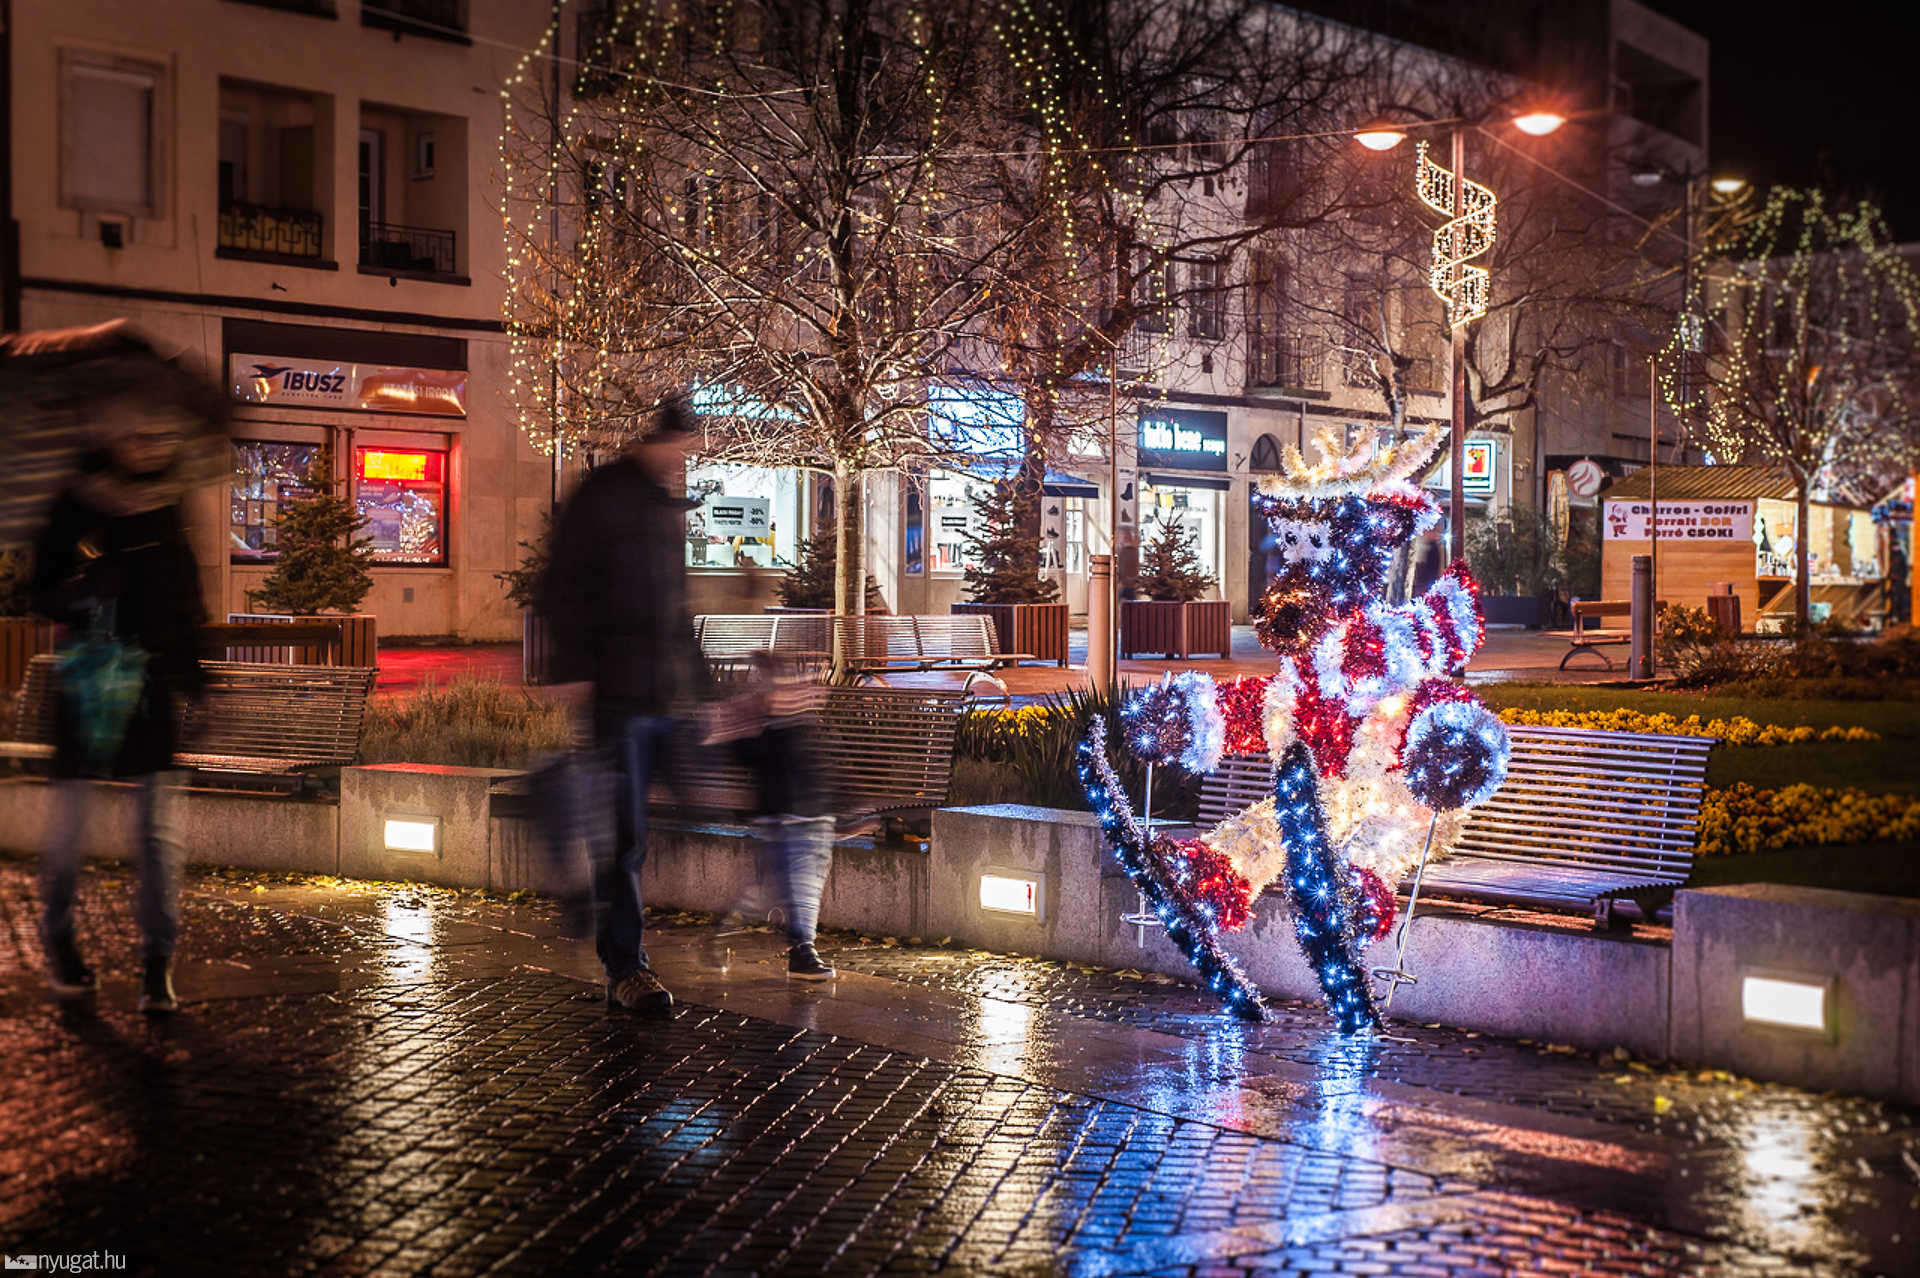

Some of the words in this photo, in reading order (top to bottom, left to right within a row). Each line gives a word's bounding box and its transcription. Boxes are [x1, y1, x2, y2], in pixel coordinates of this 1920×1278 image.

[283, 372, 346, 393] IBUSZ
[1631, 505, 1690, 515] Chrros
[1687, 528, 1733, 538] CSOKI
